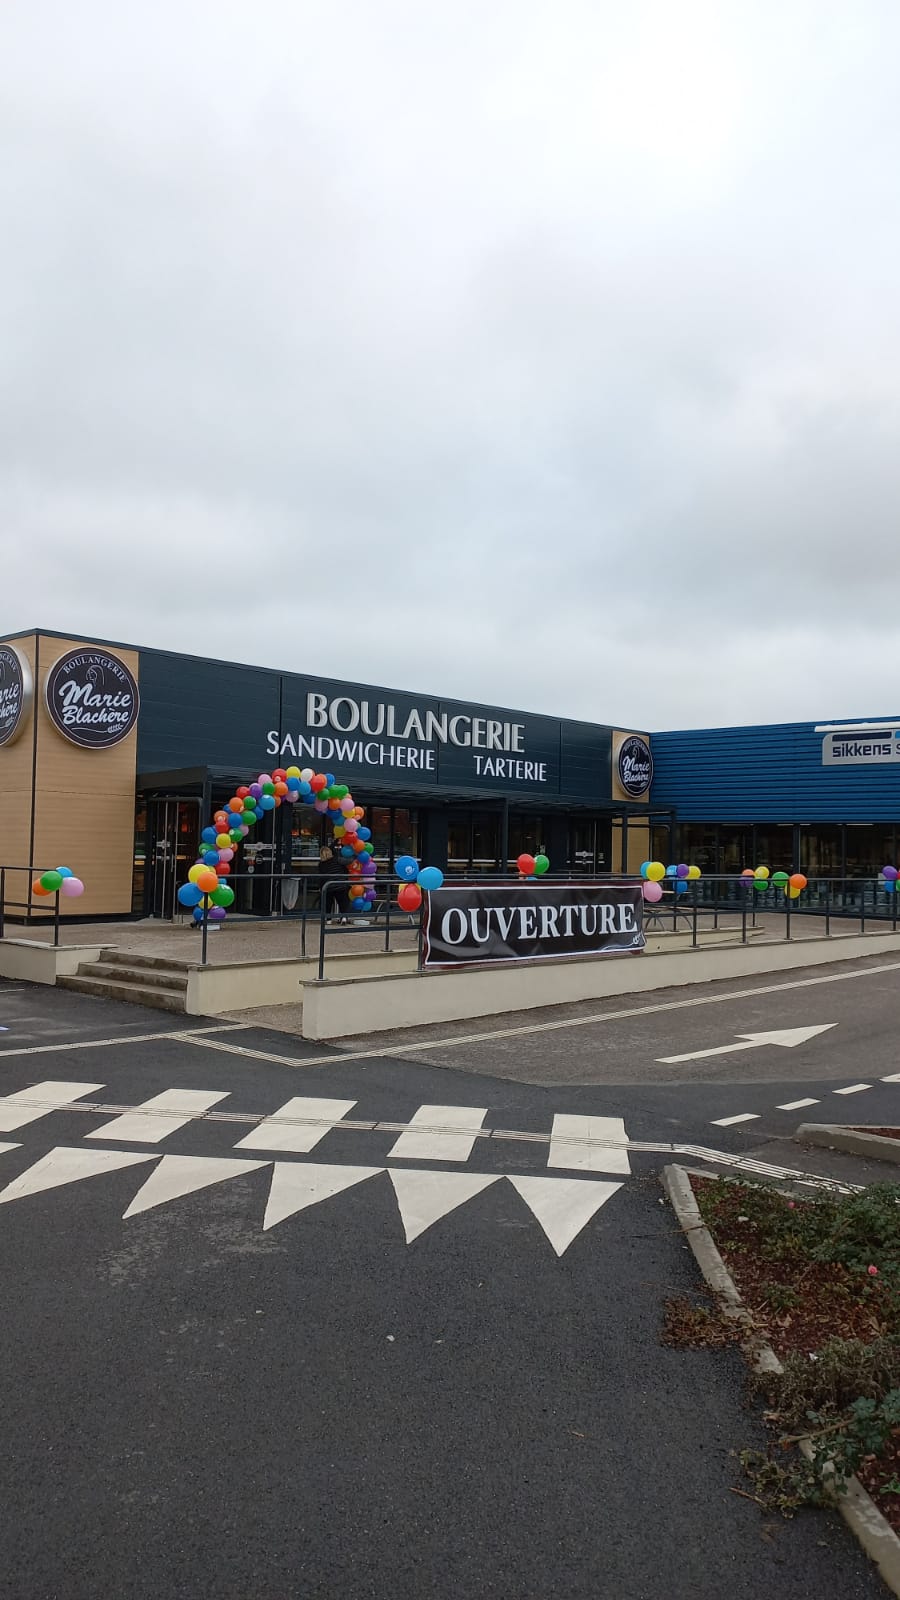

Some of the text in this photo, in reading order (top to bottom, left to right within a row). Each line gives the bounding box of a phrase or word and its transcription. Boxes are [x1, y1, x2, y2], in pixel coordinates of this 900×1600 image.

[63, 656, 127, 683] BOULANGERIE
[59, 680, 132, 708] Marie
[62, 705, 129, 725] Blachère
[306, 692, 525, 753] BOULANGERIE
[266, 730, 547, 782] SANDWICHERIE TARTERIE
[622, 755, 650, 772] Marie
[832, 742, 892, 758] sikkens
[441, 903, 638, 944] OUVERTURE
